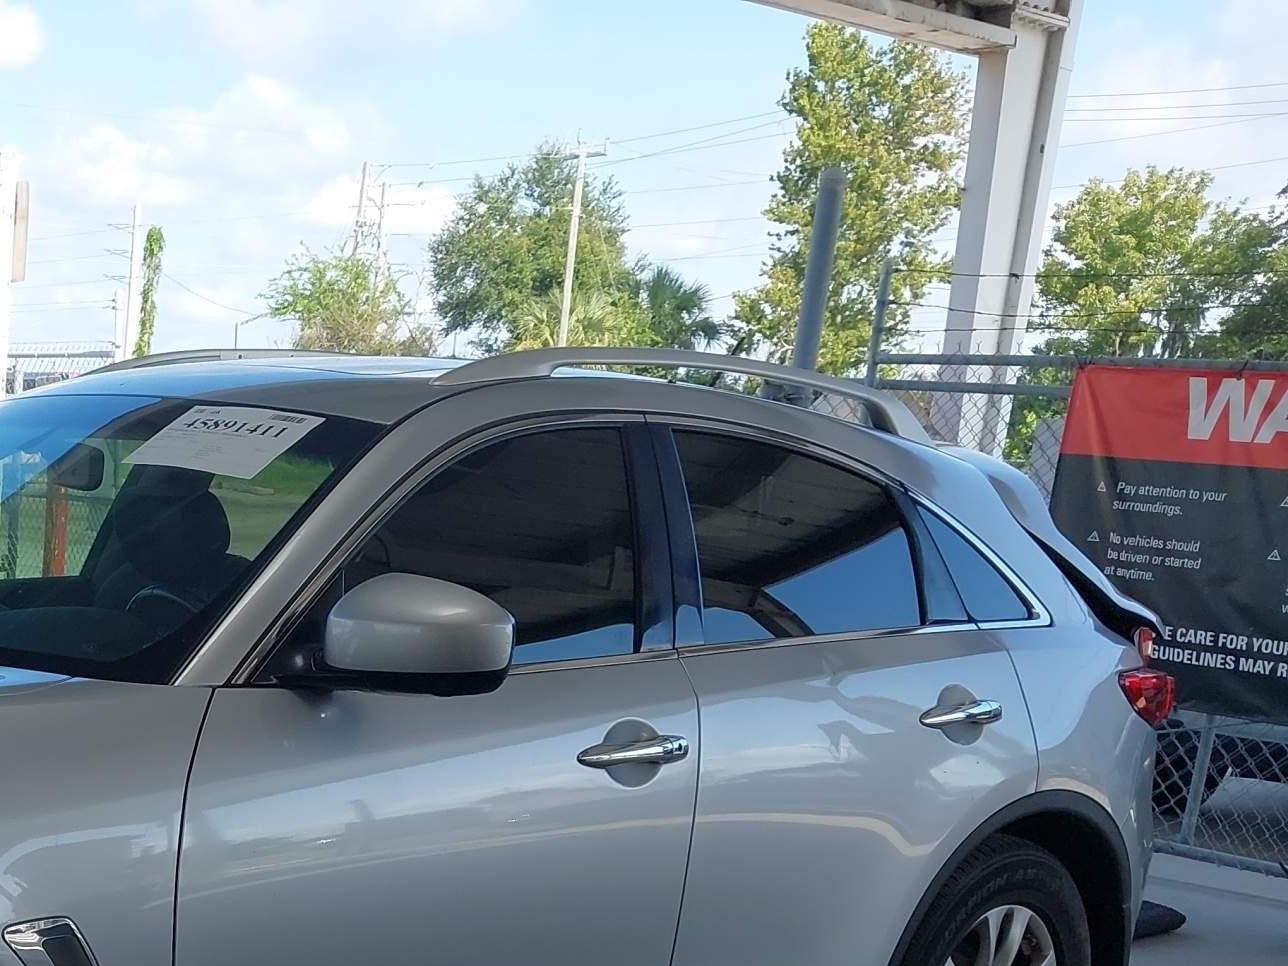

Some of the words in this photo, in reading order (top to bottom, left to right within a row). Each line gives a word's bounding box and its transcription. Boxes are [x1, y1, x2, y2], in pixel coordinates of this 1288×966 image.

[183, 418, 288, 438] 45891411
[1116, 482, 1137, 496] Pay
[1139, 485, 1186, 499] attention
[1189, 489, 1200, 500] to
[1202, 491, 1228, 502] your
[1112, 500, 1183, 517] surroundings.
[1109, 532, 1121, 544] No
[1123, 535, 1164, 549] vehicles
[1165, 539, 1200, 552] should
[1107, 548, 1118, 560] be
[1119, 550, 1150, 564] driven
[1152, 556, 1162, 565] or
[1164, 556, 1202, 569] started
[1104, 566, 1115, 575] at
[1116, 567, 1155, 581] anytime.
[1176, 627, 1215, 646] CARE
[1218, 633, 1248, 651] FOR
[1151, 644, 1235, 670] GUIDELINES
[1239, 657, 1274, 675] MAY
